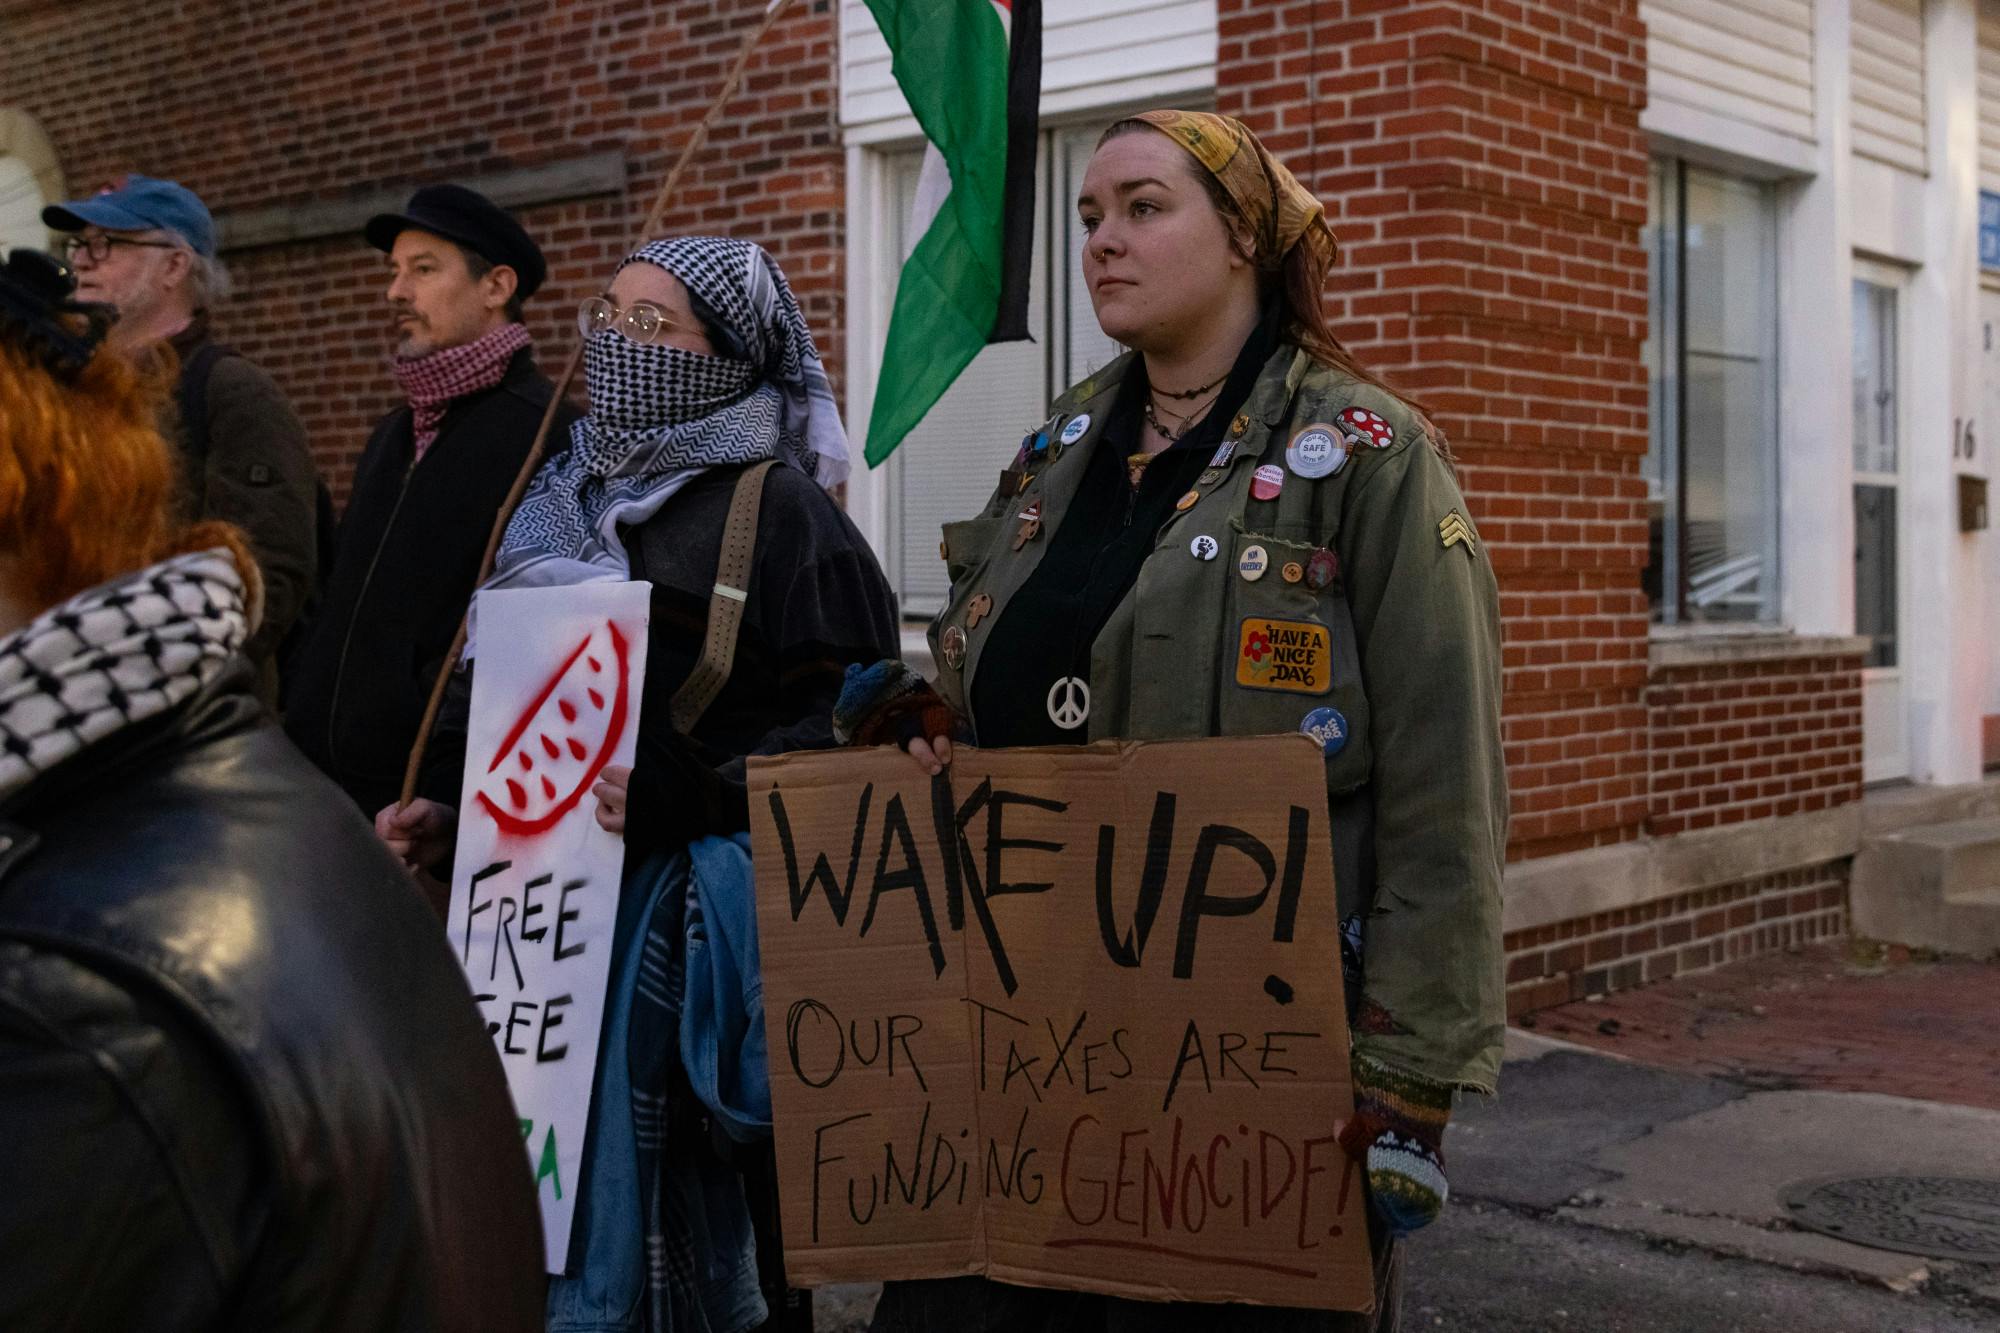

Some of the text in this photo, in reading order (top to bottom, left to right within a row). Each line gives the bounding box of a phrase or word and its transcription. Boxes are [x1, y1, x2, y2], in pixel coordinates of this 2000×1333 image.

[1303, 444, 1326, 452] SAFE
[1953, 417, 1976, 460] 16
[1266, 624, 1324, 649] HAVE A
[1273, 646, 1317, 666] NICE
[1269, 664, 1316, 687] DAY
[768, 774, 1310, 1005] WAKE UP!
[463, 859, 592, 992] FREE
[960, 998, 1133, 1103] TAXES
[1162, 1018, 1321, 1113] ARE
